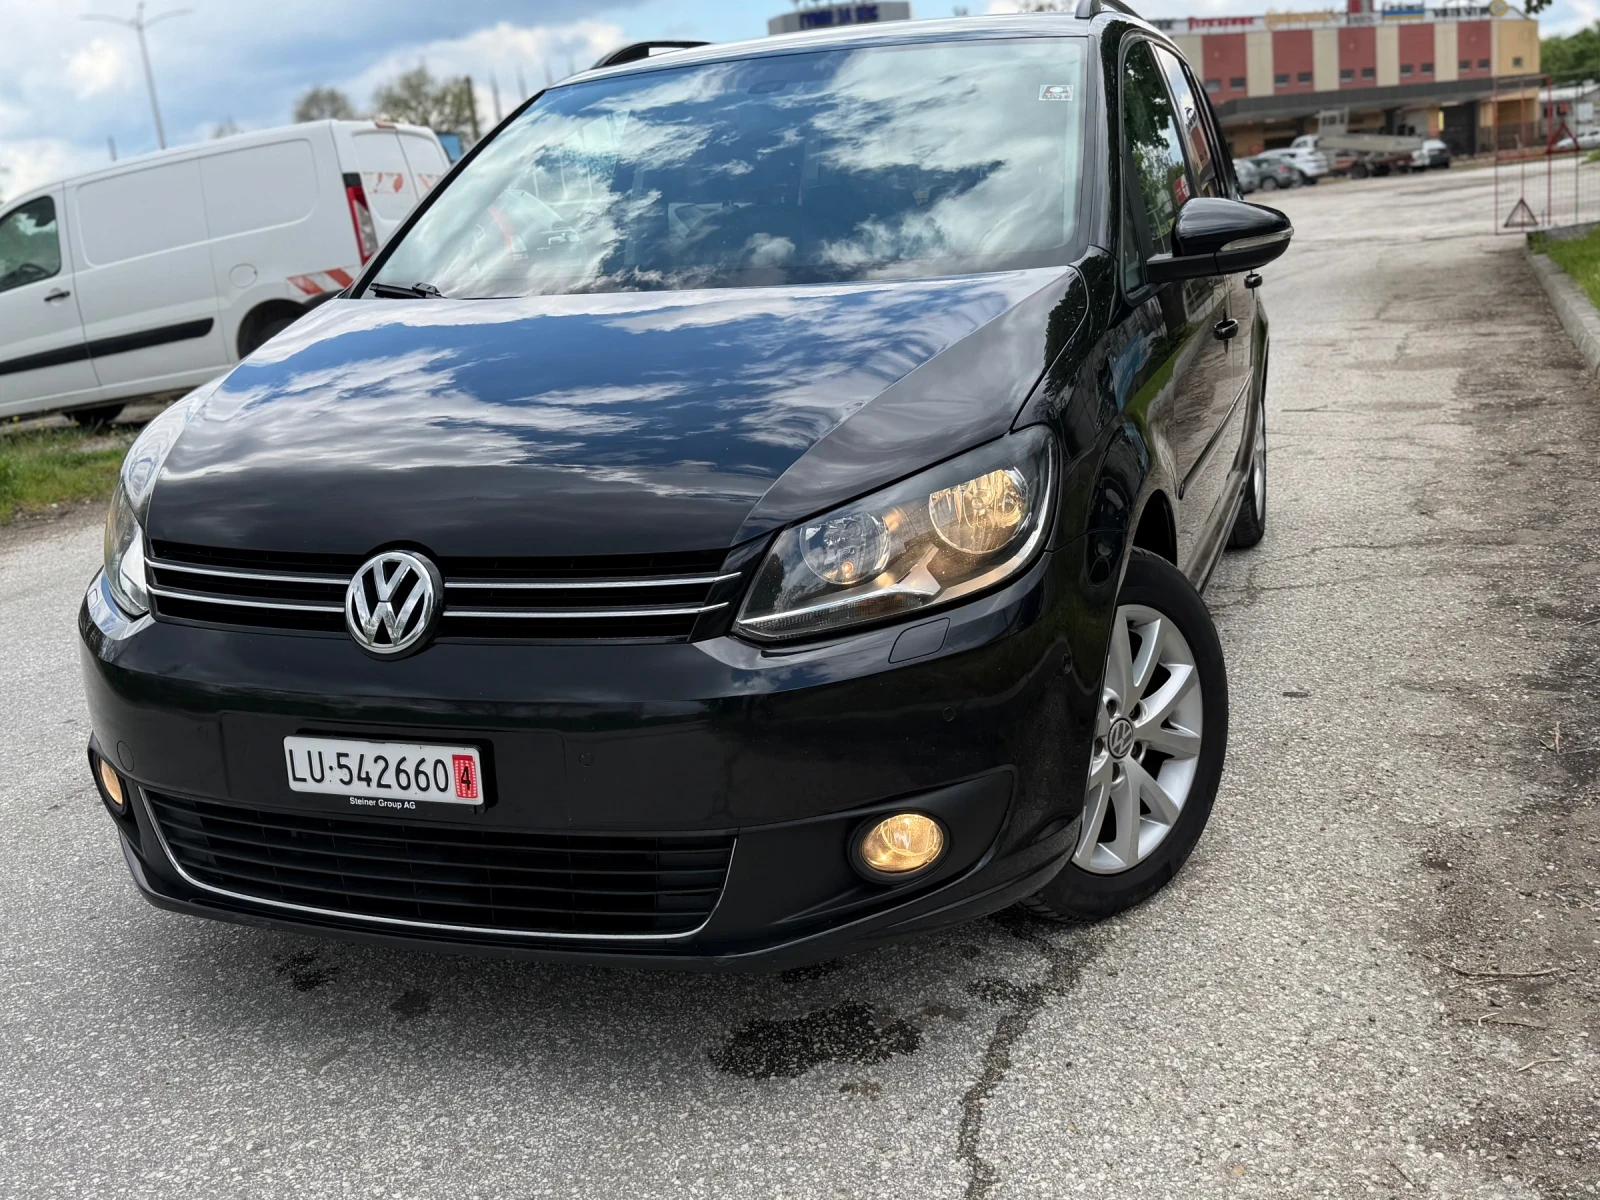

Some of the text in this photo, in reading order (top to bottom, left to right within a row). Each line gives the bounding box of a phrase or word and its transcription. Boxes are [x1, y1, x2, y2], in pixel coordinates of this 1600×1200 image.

[460, 765, 471, 791] 4
[349, 796, 416, 810] Steiner Group AG
